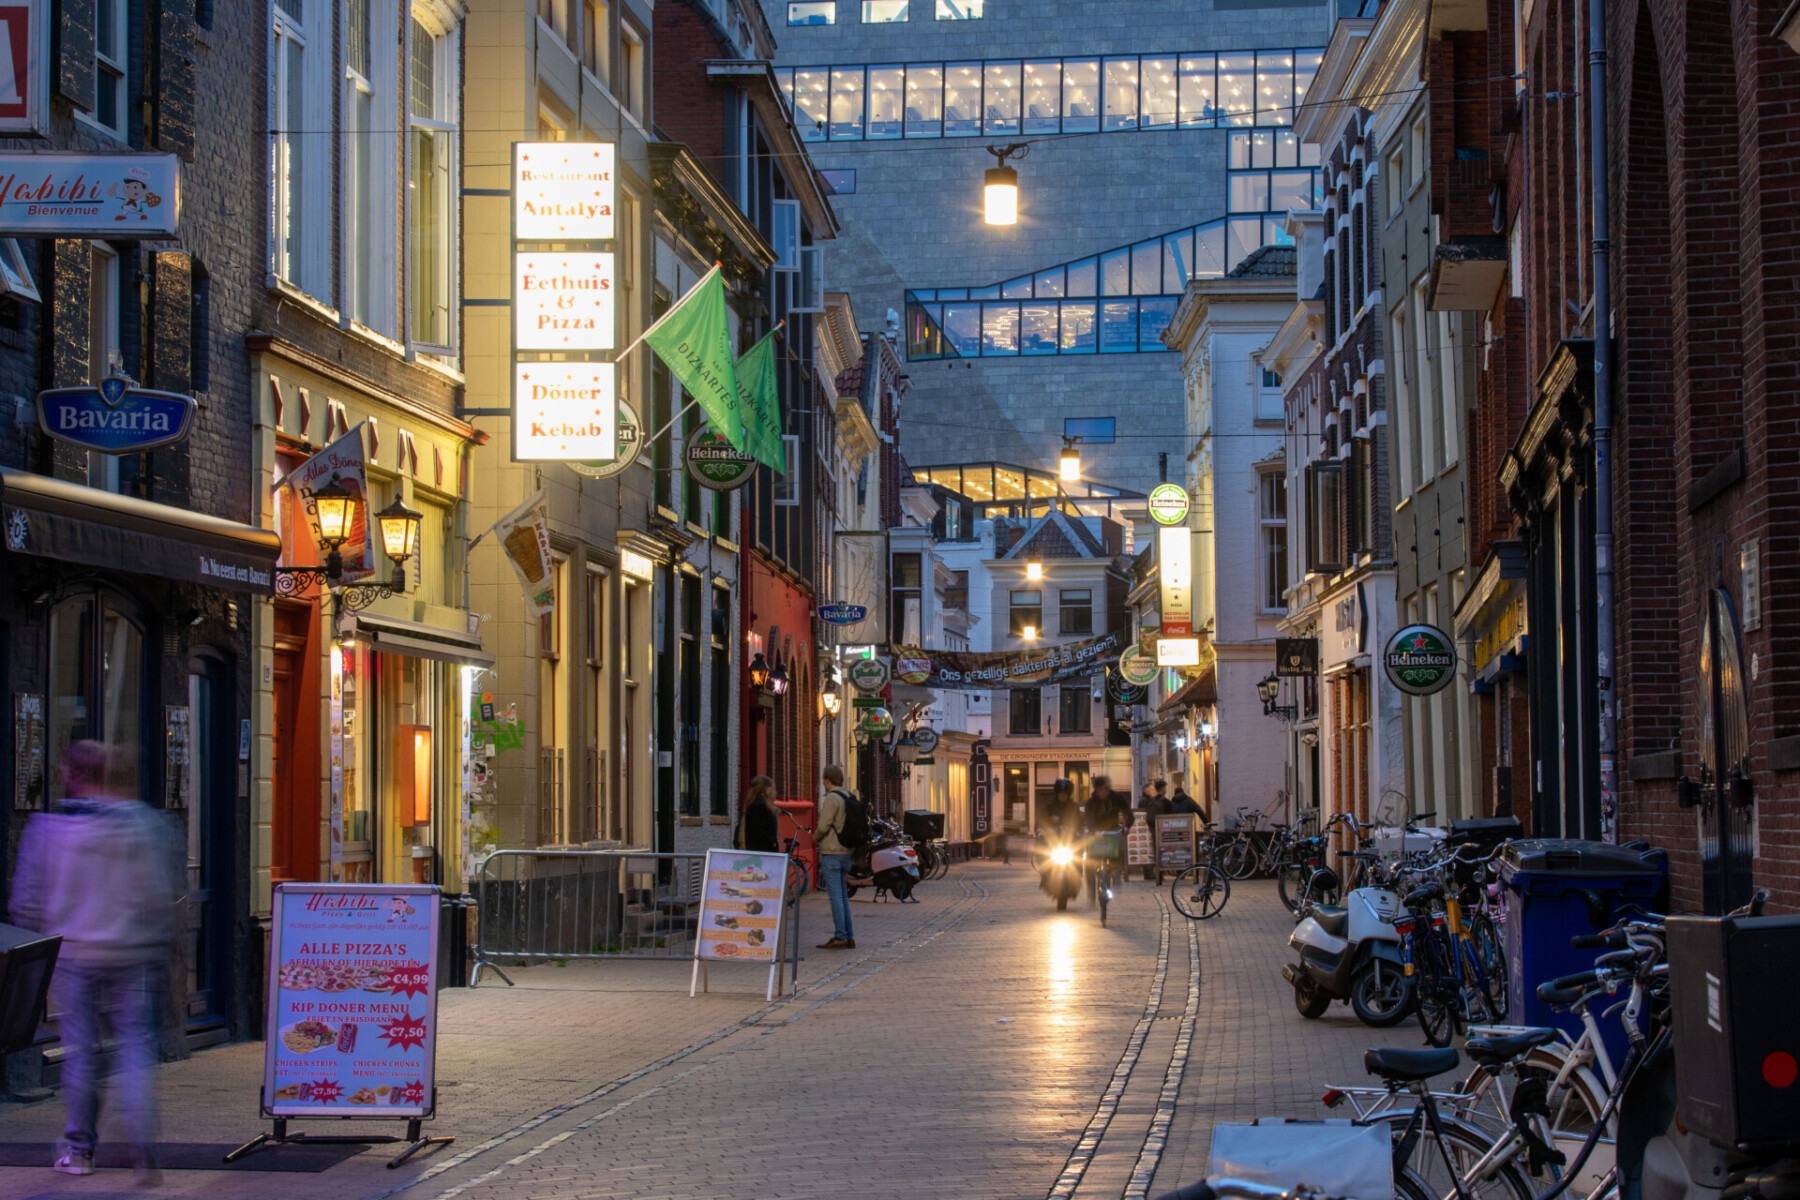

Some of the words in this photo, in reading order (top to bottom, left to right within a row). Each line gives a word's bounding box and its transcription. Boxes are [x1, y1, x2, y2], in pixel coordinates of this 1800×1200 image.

[521, 170, 610, 181] Restaurant
[28, 205, 99, 216] Bienvenue
[523, 201, 611, 219] Antalya
[523, 275, 610, 290] Eethuis
[557, 294, 575, 309] &
[537, 315, 595, 329] Pizza
[677, 342, 737, 411] DIZKARTES
[531, 384, 601, 400] Döner
[59, 405, 170, 431] Bavaria
[530, 423, 602, 437] Kebab
[691, 447, 752, 460] Heineken
[1152, 499, 1185, 507] Heineken
[823, 610, 861, 619] Bavaria
[1390, 652, 1451, 666] Heineken
[940, 668, 960, 681] Ons
[964, 665, 1009, 683] gezellige
[1012, 655, 1060, 676] dakterras
[1063, 651, 1074, 663] al
[305, 892, 378, 912] Habibi
[299, 942, 340, 955] ALLE
[345, 943, 407, 956] PIZZA'S
[353, 959, 377, 968] HIER
[393, 973, 429, 986] €4,99
[291, 1002, 315, 1012] KIP
[318, 1001, 365, 1013] DÖNER
[369, 1003, 410, 1014] MENU
[389, 1027, 424, 1039] €7,50
[389, 1060, 420, 1068] CHUNKS
[313, 1088, 338, 1096] €7,50
